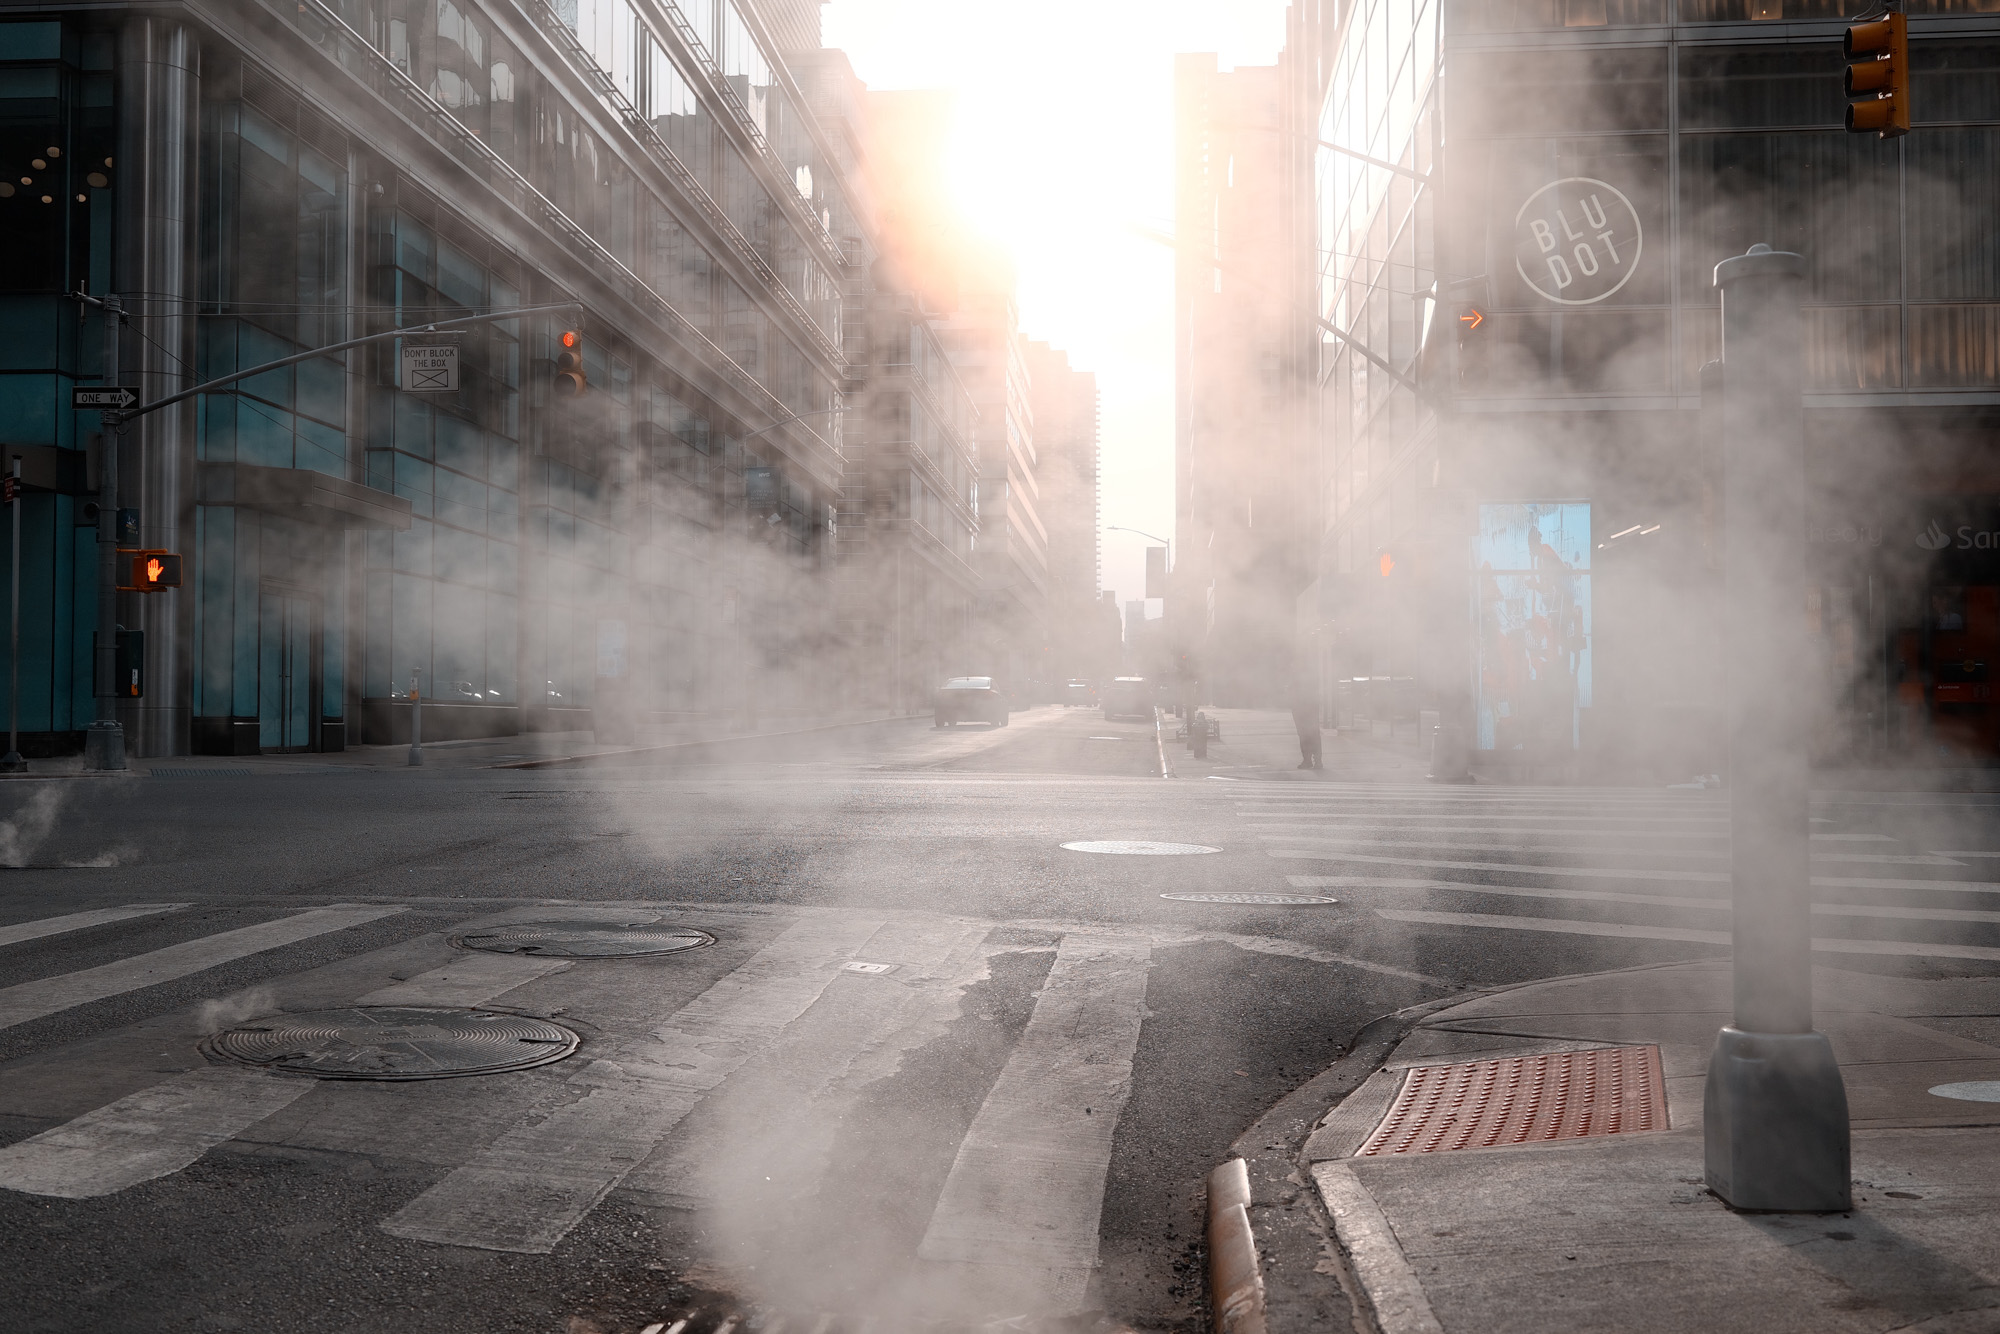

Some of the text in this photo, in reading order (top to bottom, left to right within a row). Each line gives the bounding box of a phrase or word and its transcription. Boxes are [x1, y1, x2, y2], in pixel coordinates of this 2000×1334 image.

[1529, 193, 1607, 254] BLU
[1546, 229, 1621, 290] DOT
[404, 348, 455, 358] DON'T BLOCK
[413, 358, 447, 368] THE BOX
[81, 393, 130, 403] ONE WAY
